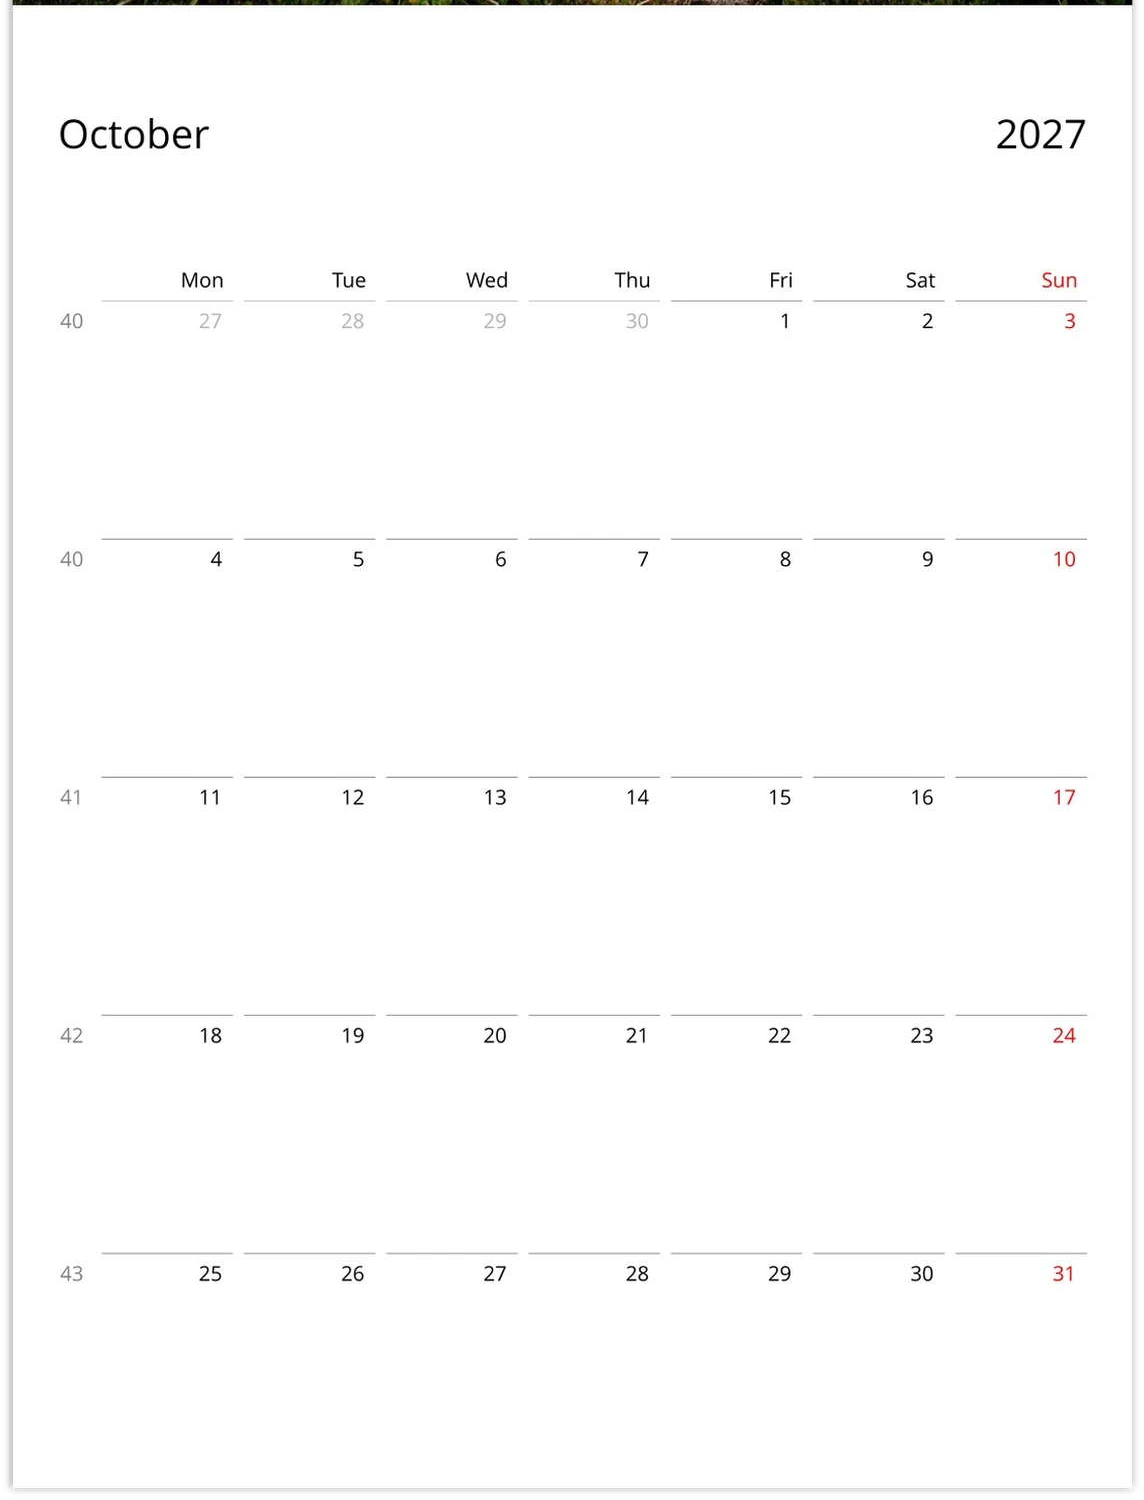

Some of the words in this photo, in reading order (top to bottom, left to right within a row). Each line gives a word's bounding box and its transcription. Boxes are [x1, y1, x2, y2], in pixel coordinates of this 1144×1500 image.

[59, 117, 210, 150] October
[996, 118, 1086, 150] 2027
[181, 271, 224, 289] Mon
[331, 271, 367, 289] Tue
[465, 270, 508, 289] Wed
[614, 270, 650, 289] Thu
[770, 271, 793, 289] Fri
[905, 271, 936, 289] Sat
[1041, 271, 1078, 289] Sun
[60, 312, 83, 329] 40
[199, 313, 222, 329] 27
[342, 313, 364, 329] 28
[484, 313, 506, 329] 29
[627, 313, 649, 329] 30
[781, 312, 788, 329] 1
[921, 312, 934, 329] 2
[1064, 312, 1076, 330] 3
[60, 550, 83, 568] 40
[210, 550, 223, 568] 4
[353, 550, 365, 568] 5
[495, 550, 507, 568] 6
[637, 550, 649, 568] 7
[779, 550, 792, 568] 8
[922, 550, 934, 568] 9
[1054, 550, 1076, 568] 10
[60, 789, 80, 805] 41
[200, 788, 219, 806] 11
[342, 788, 365, 806] 12
[484, 788, 507, 806] 13
[627, 788, 650, 806] 14
[769, 788, 792, 806] 15
[911, 788, 934, 806] 16
[1054, 788, 1076, 806] 17
[60, 1027, 83, 1044] 42
[200, 1026, 223, 1044] 18
[342, 1026, 365, 1044] 19
[483, 1026, 507, 1044] 20
[625, 1026, 646, 1044] 21
[768, 1026, 792, 1044] 22
[910, 1026, 934, 1044] 23
[1052, 1026, 1077, 1044] 24
[60, 1265, 83, 1282] 43
[198, 1265, 222, 1282] 25
[341, 1265, 365, 1282] 26
[483, 1265, 507, 1282] 27
[625, 1265, 649, 1282] 28
[768, 1265, 792, 1282] 29
[910, 1265, 934, 1282] 30
[1052, 1265, 1073, 1282] 31
